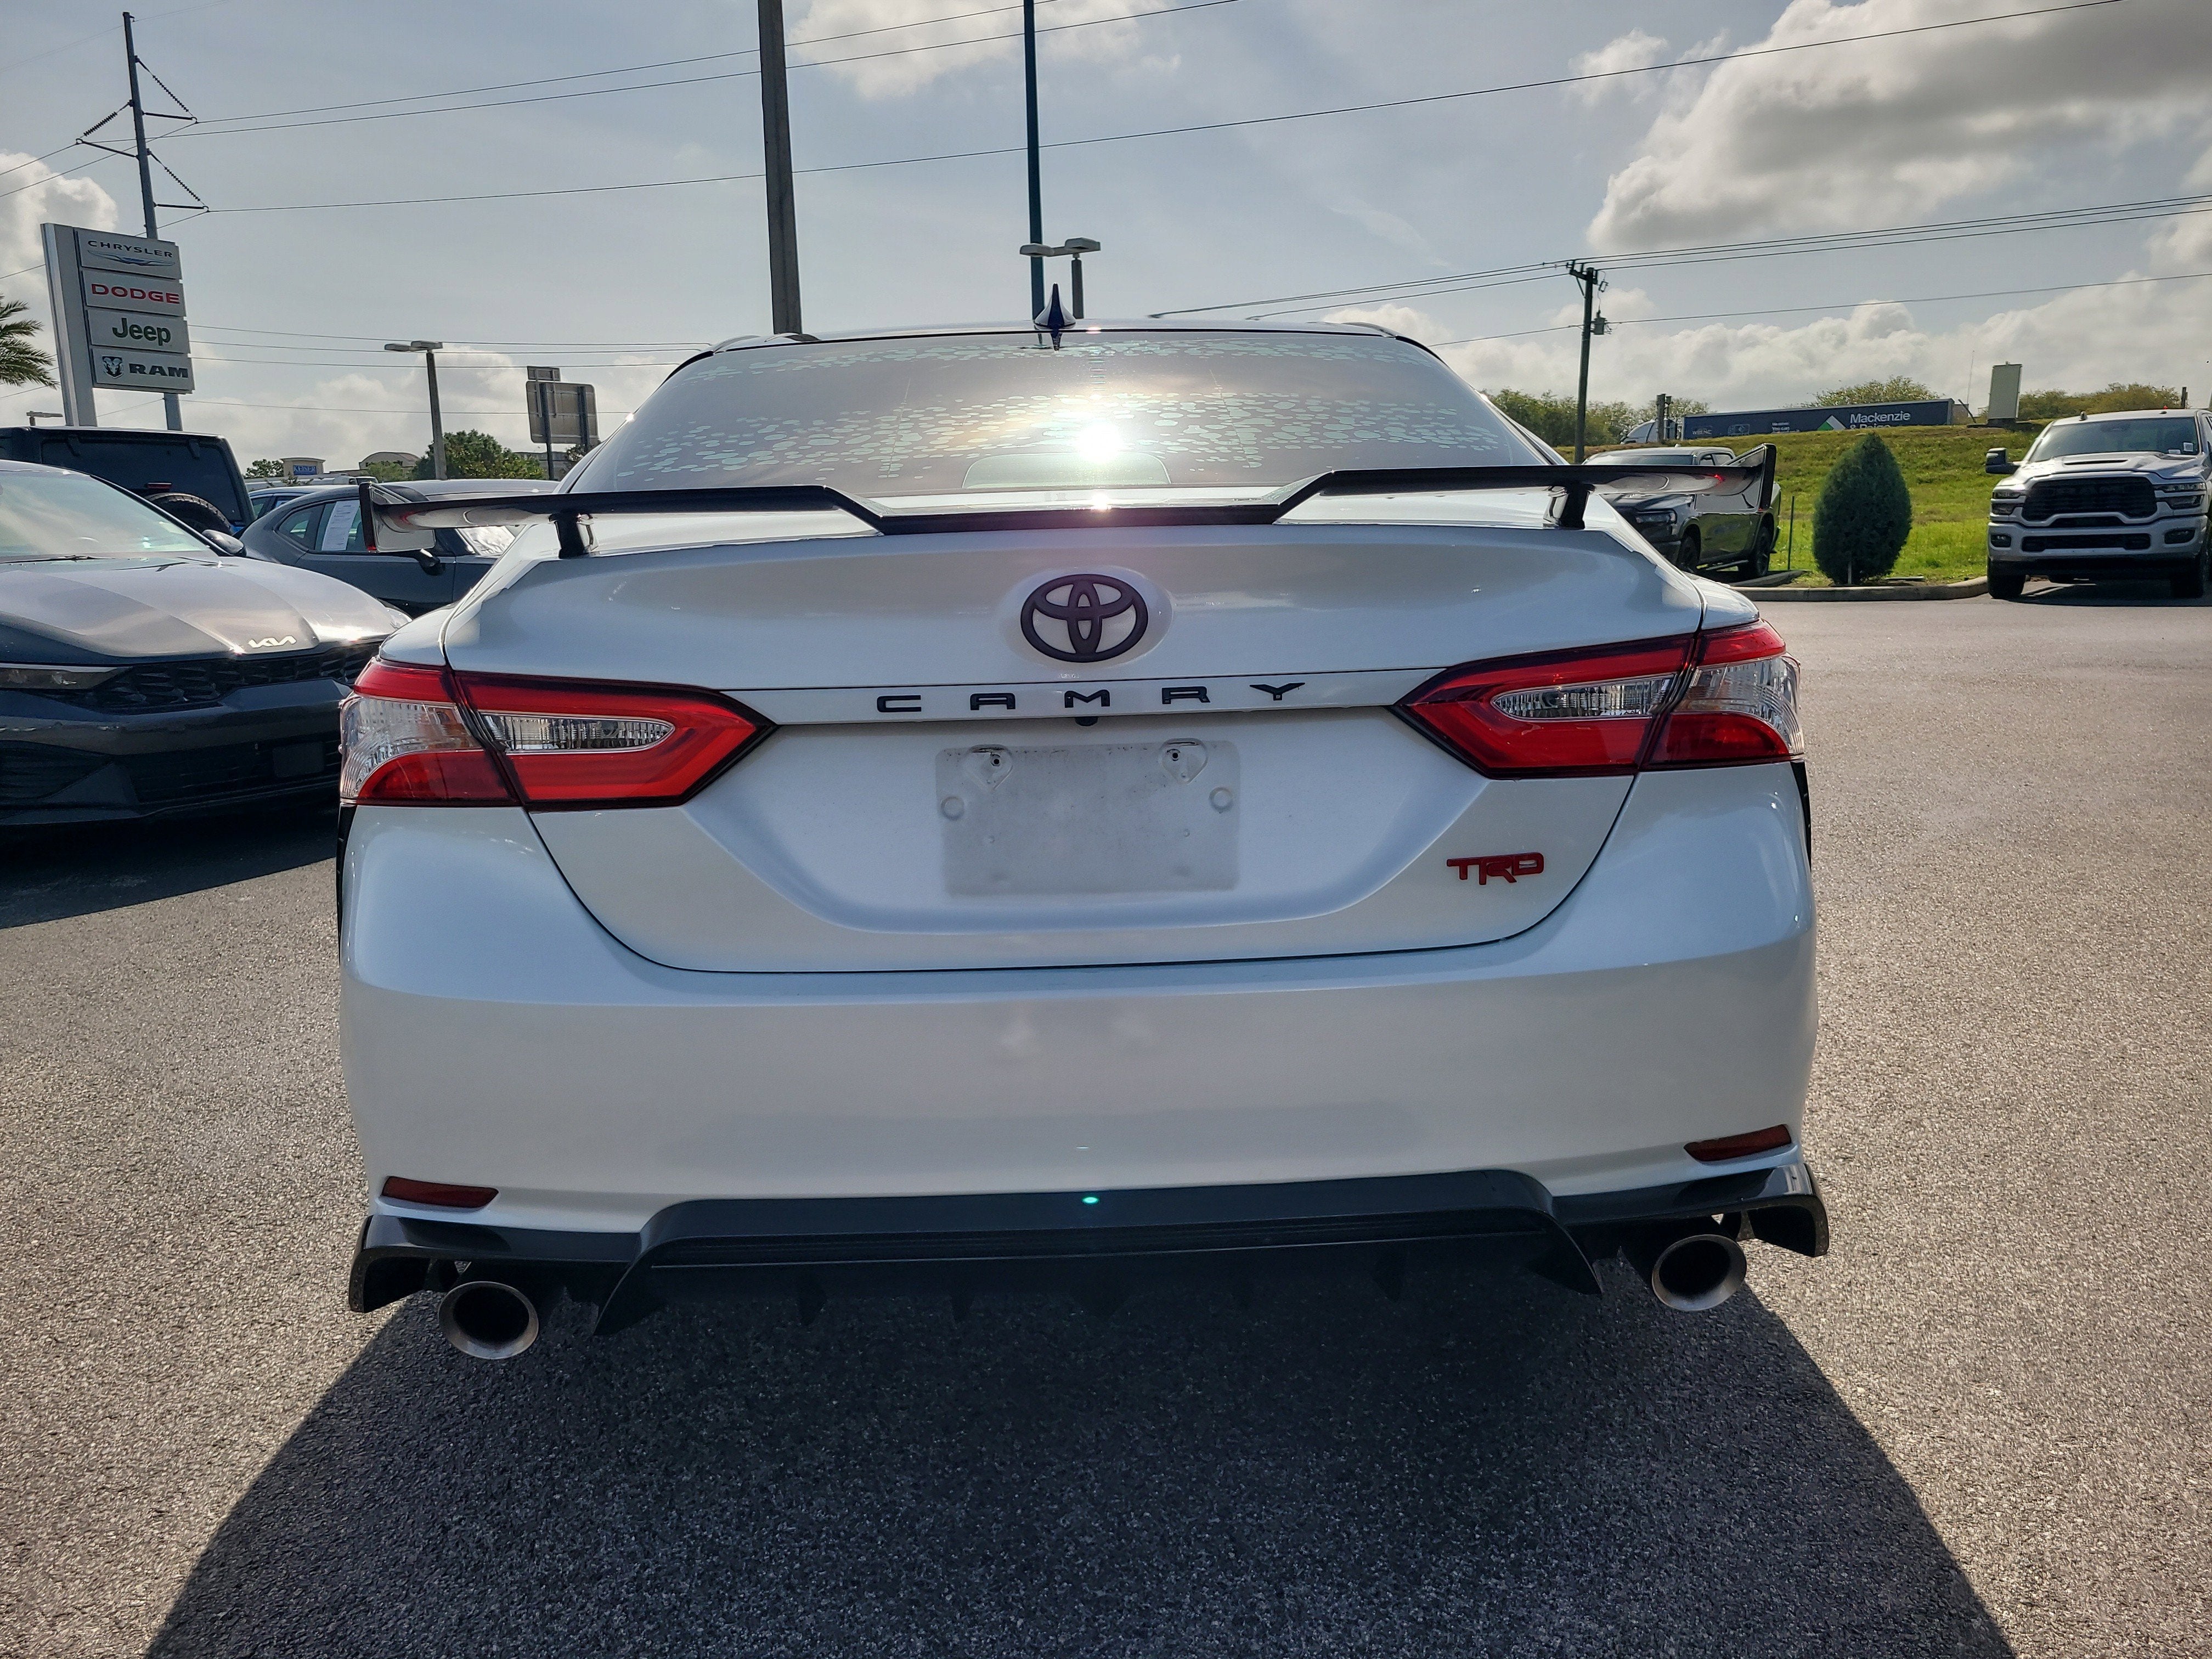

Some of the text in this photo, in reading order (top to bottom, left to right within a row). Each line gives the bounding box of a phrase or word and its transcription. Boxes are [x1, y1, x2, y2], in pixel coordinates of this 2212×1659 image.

[88, 240, 172, 257] CHRYSLER
[91, 284, 179, 304] DODGE
[112, 318, 171, 346] Jeep
[129, 363, 188, 378] RAM
[1850, 411, 1910, 424] Mackenzie
[877, 682, 1306, 713] CAMRY
[1447, 851, 1544, 885] TRD
